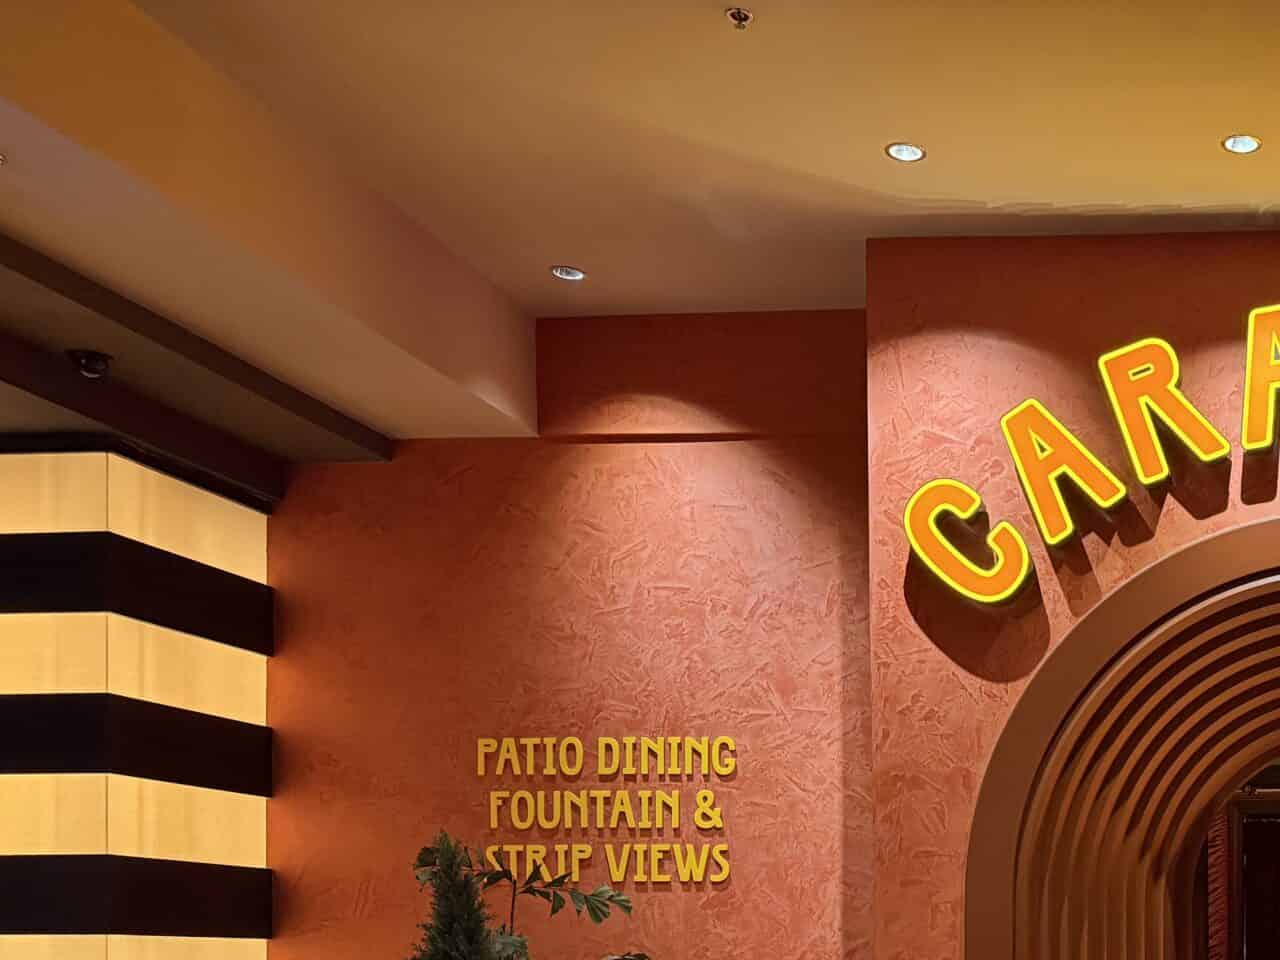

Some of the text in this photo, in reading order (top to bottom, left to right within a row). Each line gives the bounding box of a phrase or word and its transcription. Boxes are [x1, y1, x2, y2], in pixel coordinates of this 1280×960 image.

[477, 736, 736, 776] PATIO DINING
[490, 790, 722, 829] FOUNTAIN &
[486, 843, 730, 882] STRIP VIEWS
